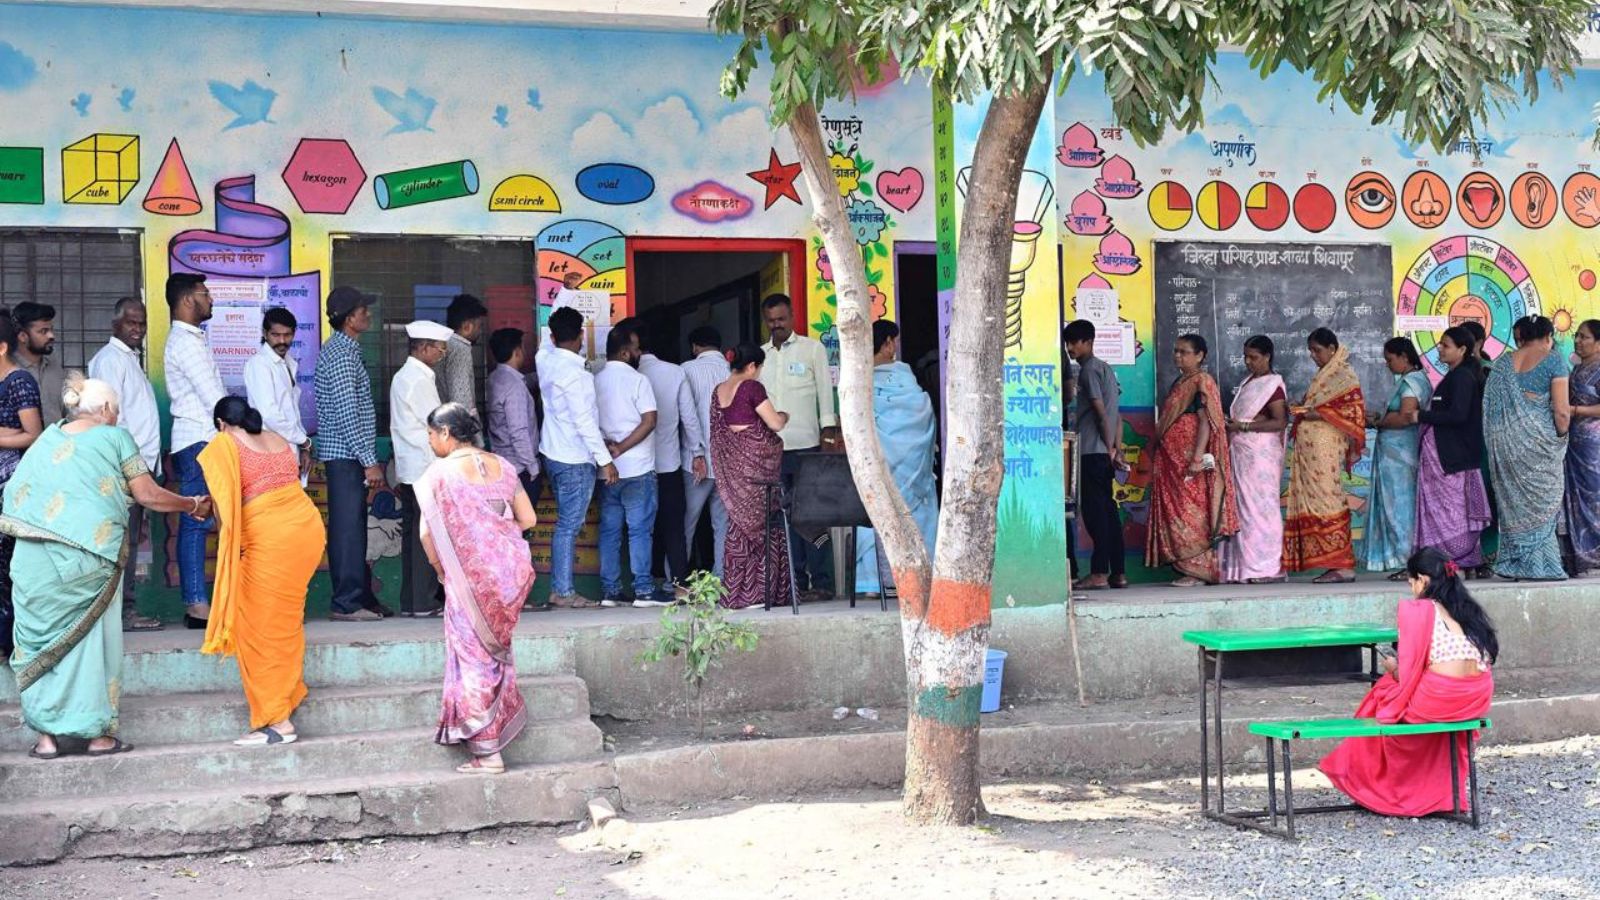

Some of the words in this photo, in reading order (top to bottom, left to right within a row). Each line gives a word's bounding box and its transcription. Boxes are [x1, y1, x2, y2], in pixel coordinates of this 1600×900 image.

[302, 172, 347, 187] hexagon
[598, 178, 620, 190] oval
[85, 186, 110, 198] cube
[400, 177, 443, 197] cylinder
[885, 185, 911, 195] heart
[158, 202, 182, 211] cone
[494, 195, 518, 206] semi
[518, 195, 545, 206] circle
[547, 230, 574, 243] met
[592, 250, 613, 261] set
[548, 261, 569, 273] let
[212, 347, 258, 356] WARNING
